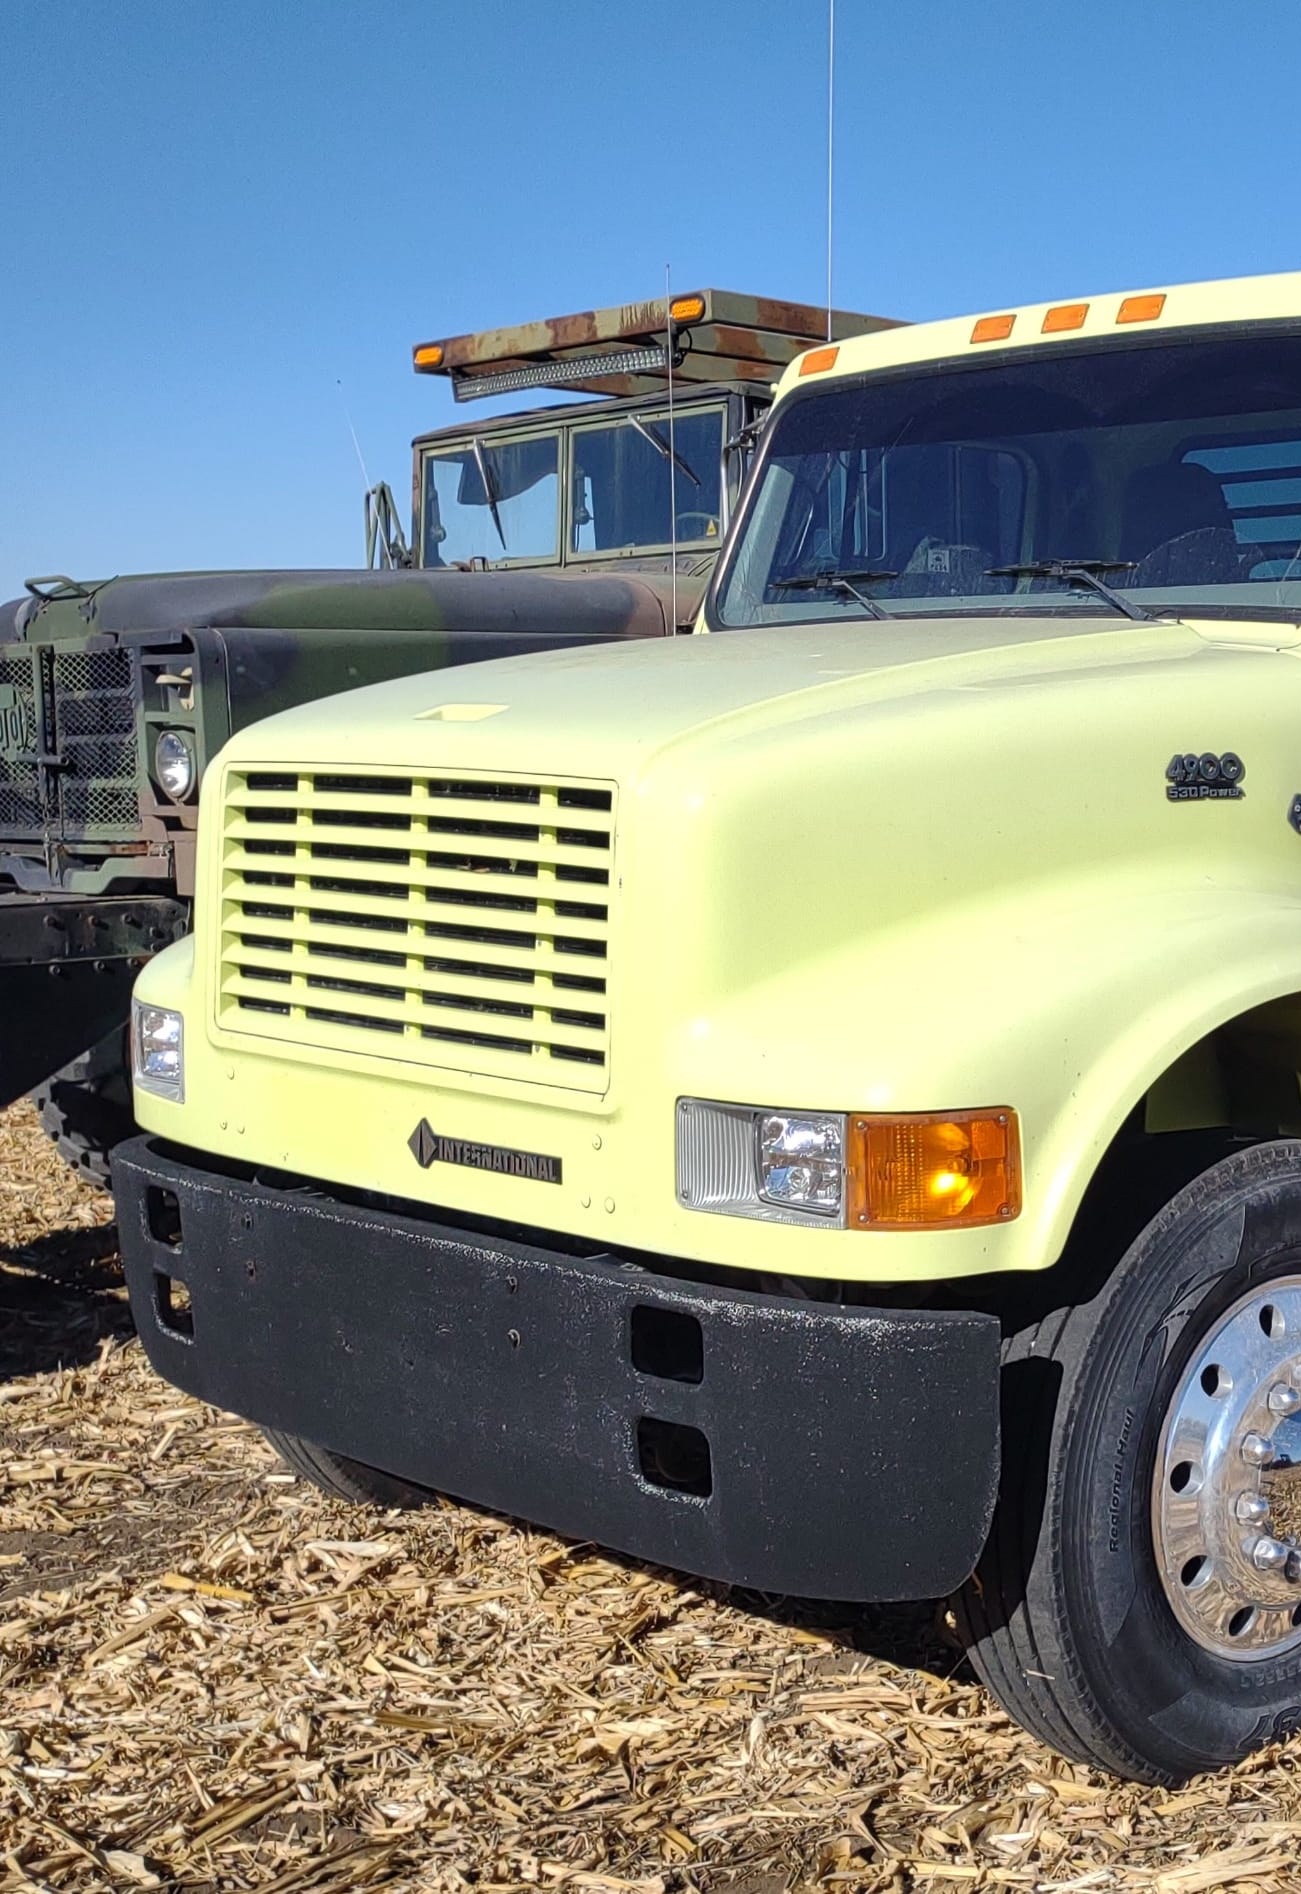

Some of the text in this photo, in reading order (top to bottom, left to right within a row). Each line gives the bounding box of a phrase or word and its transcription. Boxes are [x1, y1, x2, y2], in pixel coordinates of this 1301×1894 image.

[1168, 753, 1245, 781] 4900
[1168, 786, 1243, 799] 530 Power
[438, 1137, 556, 1181] INTERNATIONAL
[1109, 1407, 1135, 1552] Regional Haul
